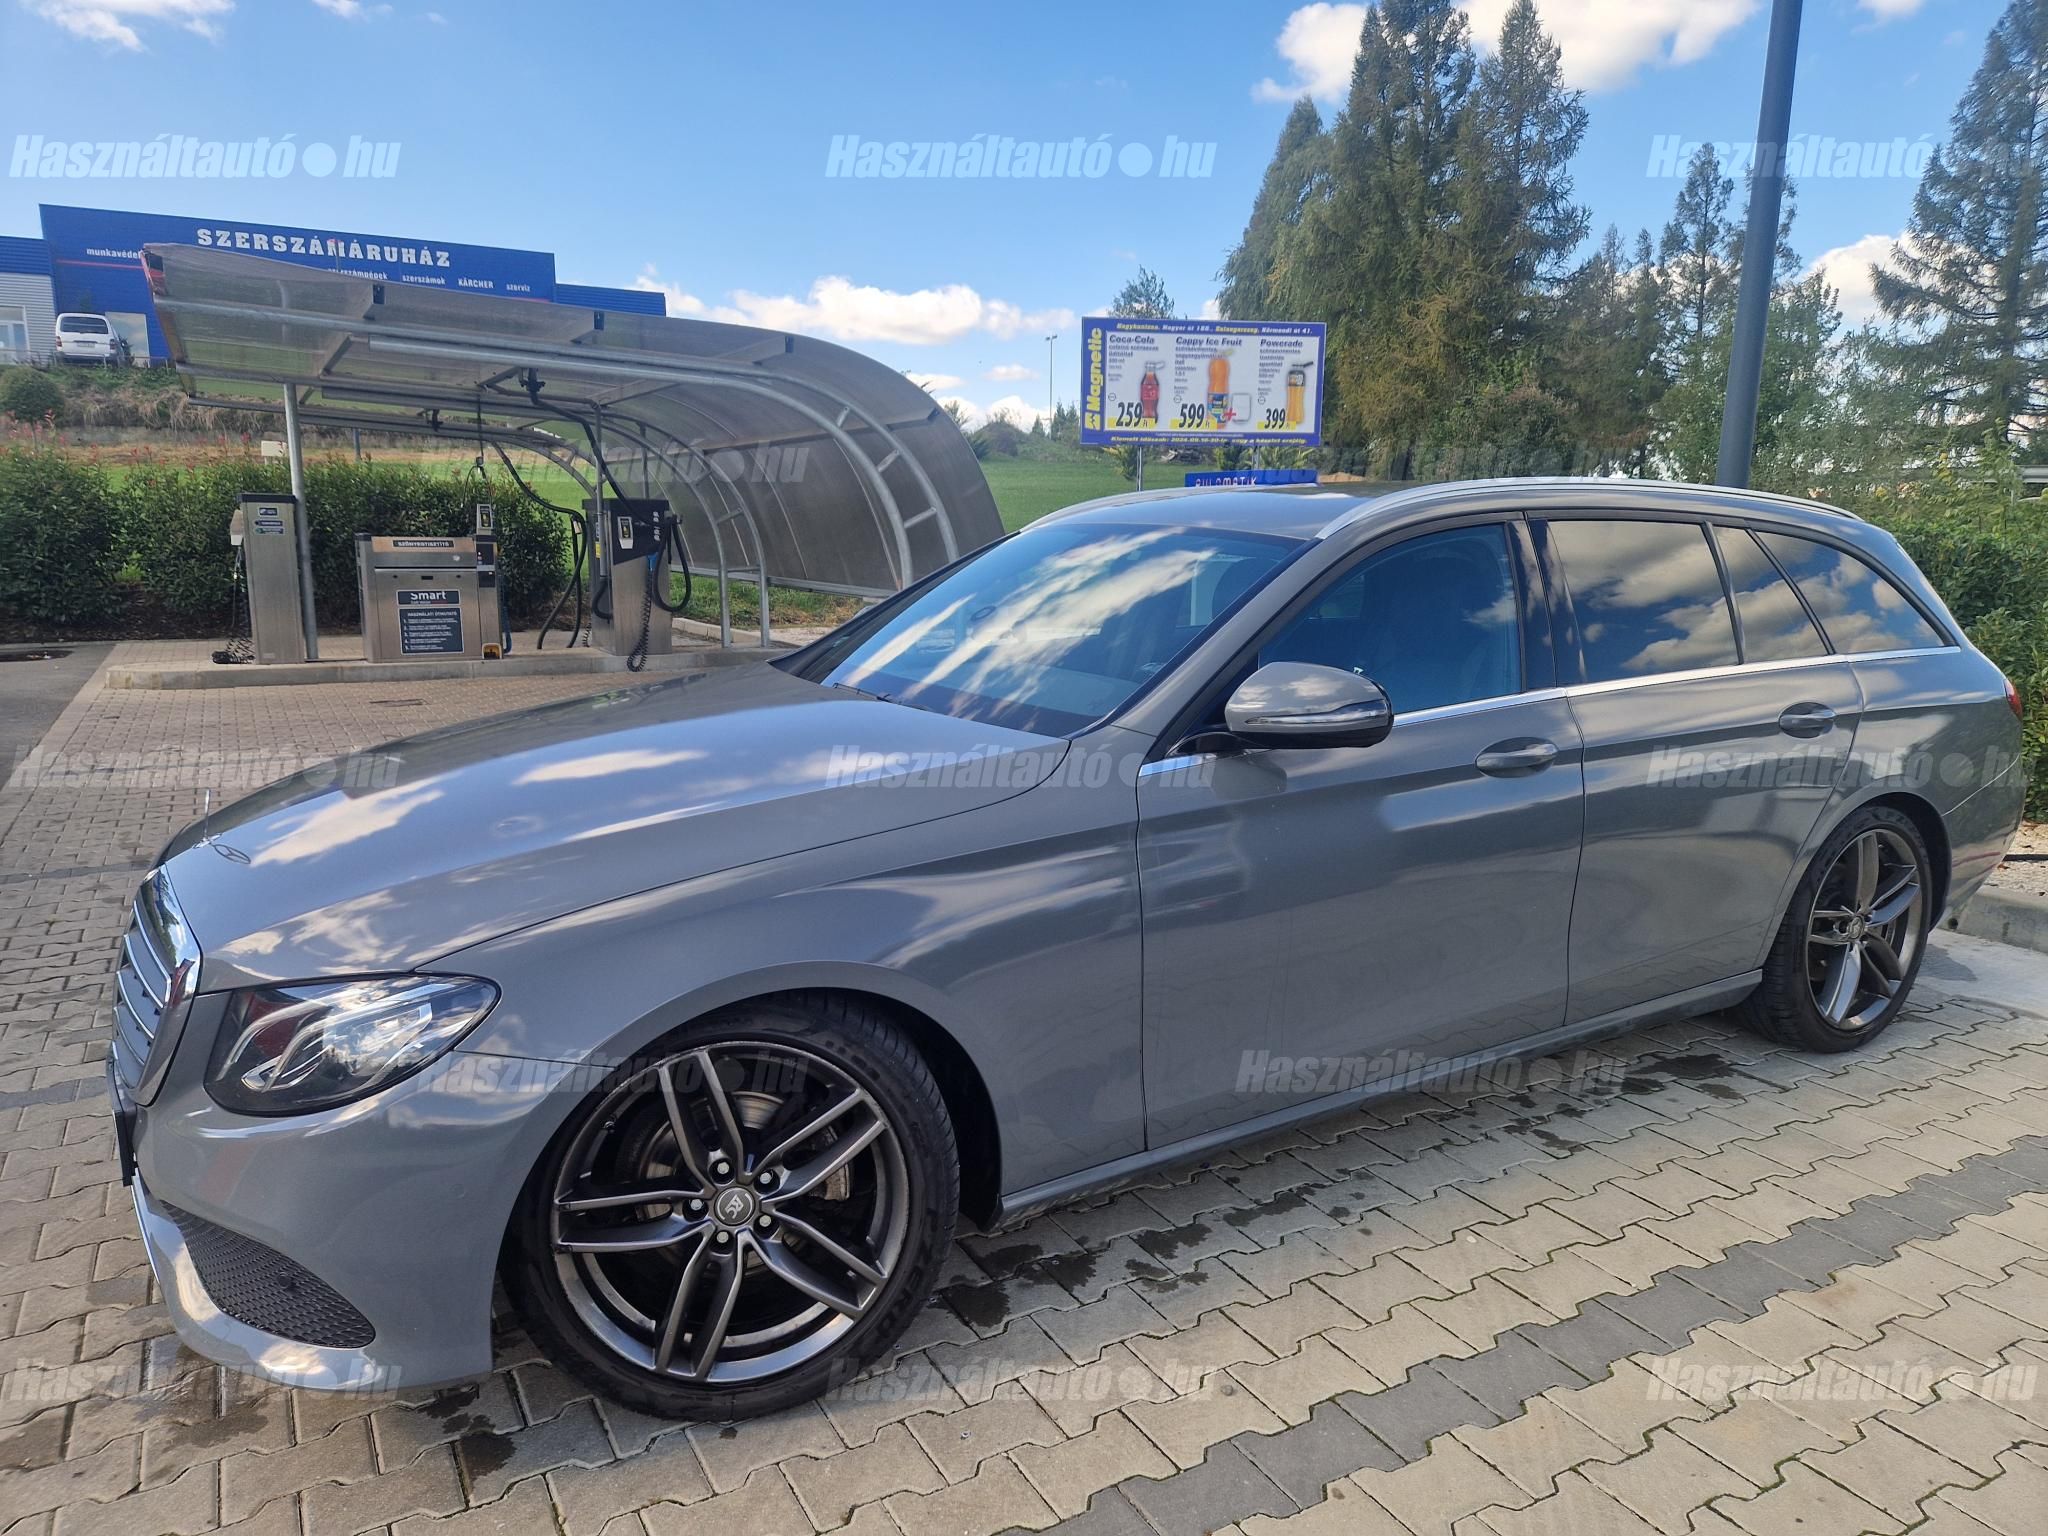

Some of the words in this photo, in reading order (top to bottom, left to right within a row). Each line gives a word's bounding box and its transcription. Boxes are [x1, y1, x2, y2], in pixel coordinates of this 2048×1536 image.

[402, 275, 443, 285] szerszámok
[1109, 335, 1155, 345] Coca-Cola
[1175, 336, 1204, 347] Cappy
[1221, 338, 1243, 346] Fruit
[1260, 338, 1303, 348] Powerade
[1116, 401, 1143, 428] 259
[1178, 403, 1205, 429] 599
[1264, 408, 1286, 429] 399
[410, 591, 447, 600] Smart
